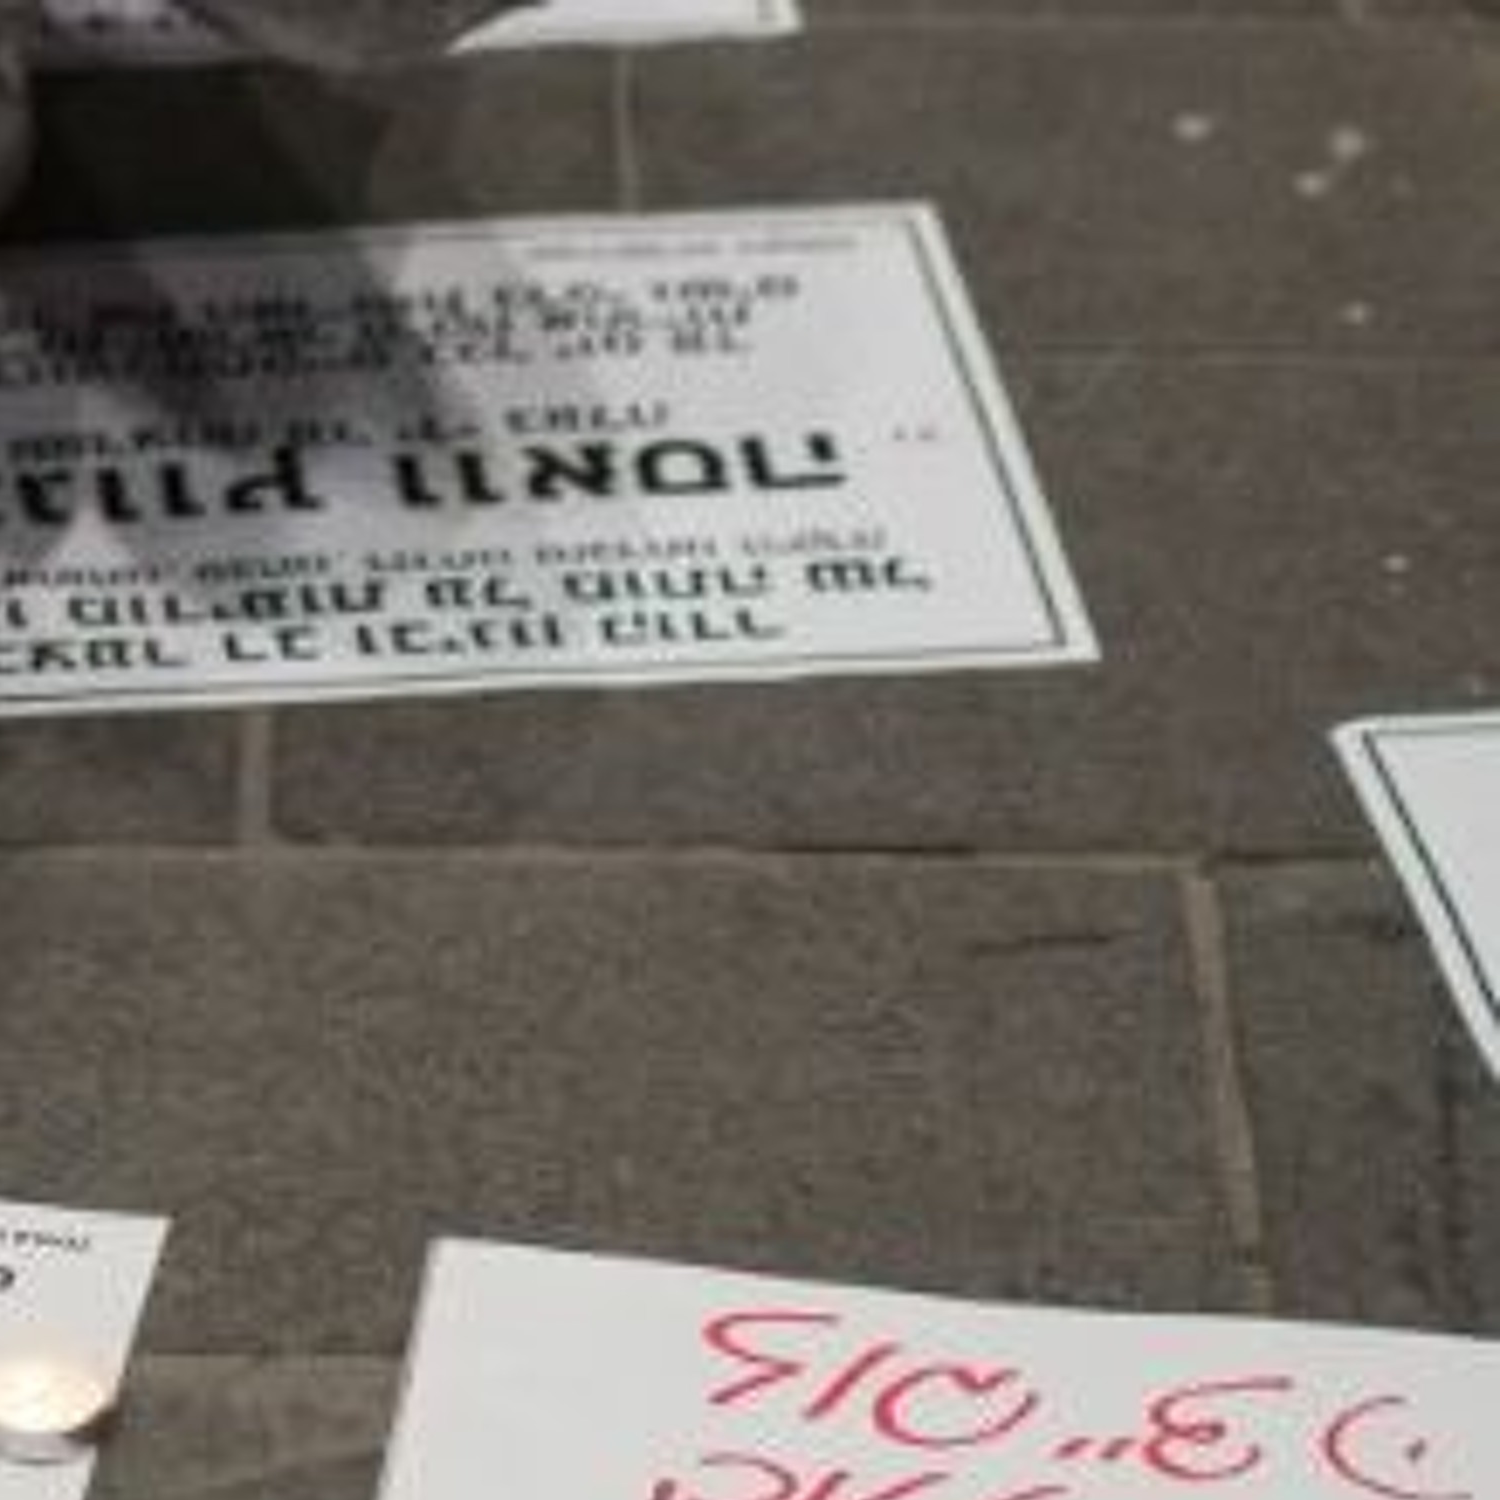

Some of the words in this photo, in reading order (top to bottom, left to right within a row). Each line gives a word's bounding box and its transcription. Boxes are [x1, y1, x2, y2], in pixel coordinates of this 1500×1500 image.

[64, 581, 385, 629] מודיעות
[423, 576, 532, 614] על
[561, 565, 772, 604] מותה
[805, 557, 933, 594] של
[223, 627, 321, 663] רב
